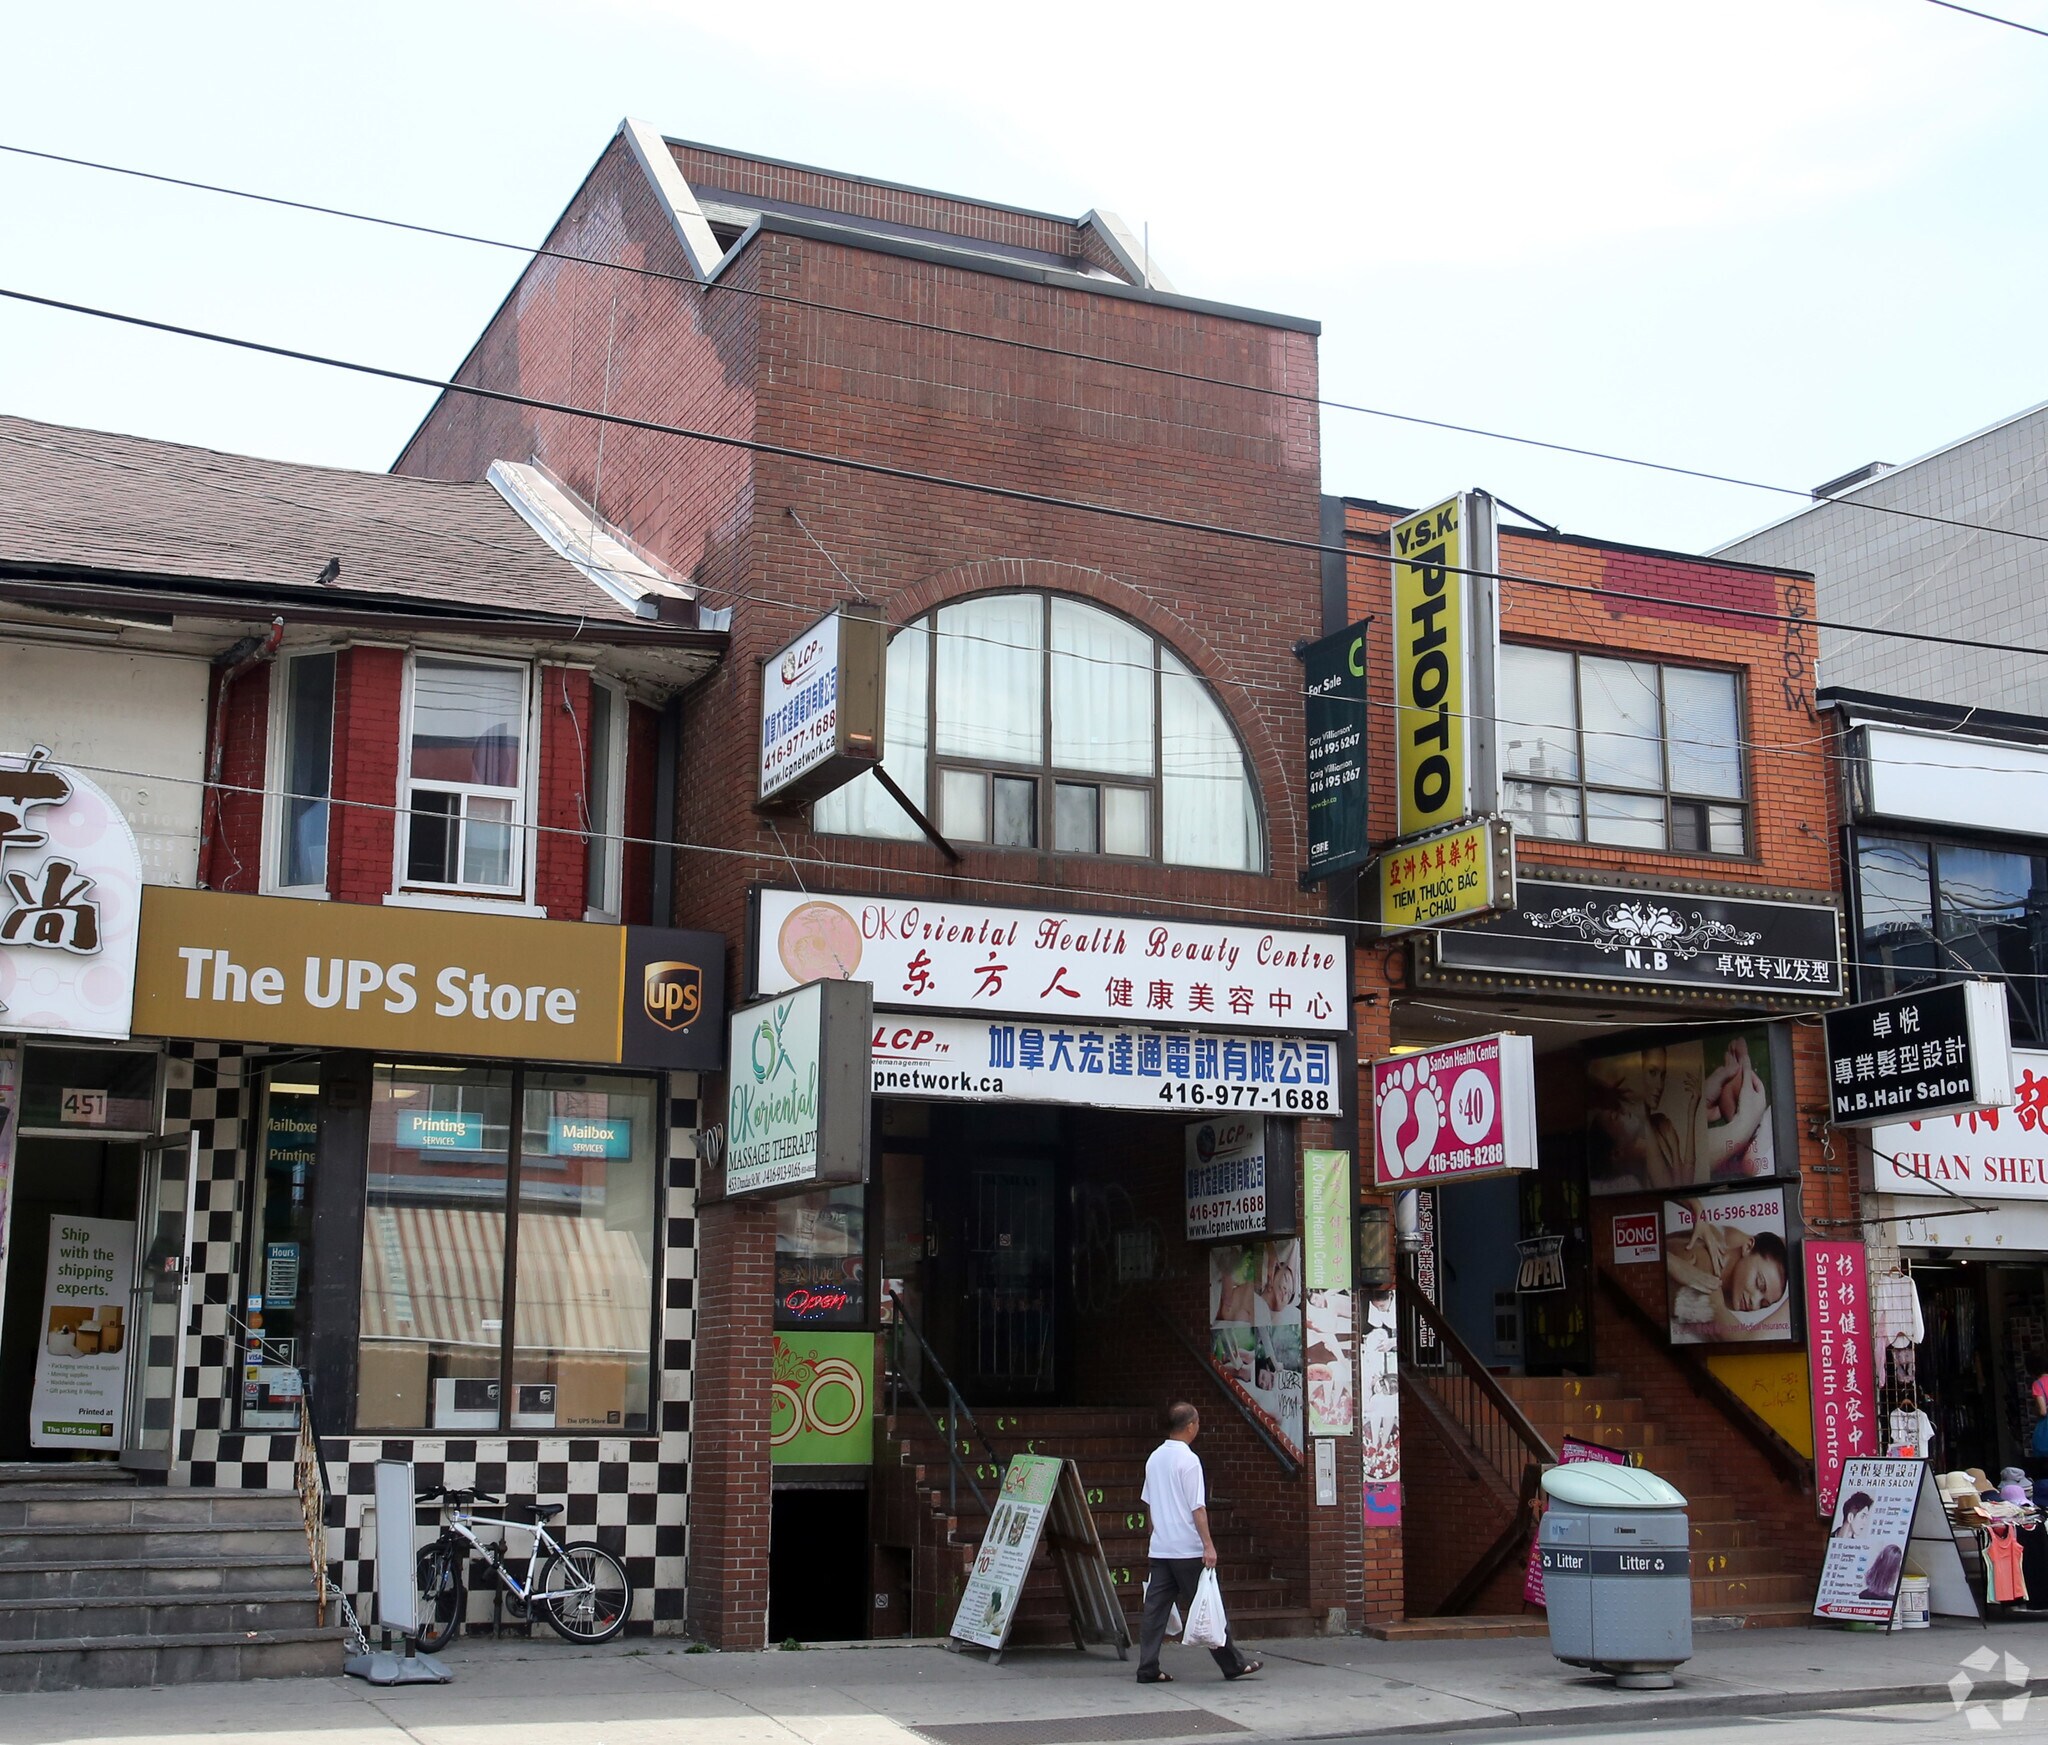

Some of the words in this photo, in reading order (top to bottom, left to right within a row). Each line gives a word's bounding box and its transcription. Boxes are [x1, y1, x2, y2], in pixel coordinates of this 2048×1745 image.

[1396, 507, 1458, 555] Y.S.K.
[797, 640, 818, 668] LCP
[1323, 674, 1342, 692] Sale
[1410, 542, 1451, 813] PHOTO
[764, 709, 836, 770] 416-977-1688
[1309, 747, 1323, 761] 416
[1340, 732, 1360, 750] 6247
[763, 735, 836, 792] www.lcpnetwork.ca
[1310, 780, 1323, 794] 416
[1342, 767, 1361, 783] 6267
[900, 907, 1018, 947] Oriental
[1034, 919, 1128, 955] Health
[1144, 926, 1241, 971] Beauty
[1256, 935, 1336, 970] Centre
[1715, 953, 1830, 984] 卓悦专业发型
[178, 947, 285, 1005] The
[304, 956, 418, 1014] UPS
[434, 966, 577, 1025] Store
[648, 981, 699, 1021] ups
[871, 1027, 934, 1051] LCP
[871, 1058, 931, 1068] elemanagement
[988, 1024, 1330, 1086] 加拿大宏達通電訊有限公司
[1429, 1052, 1453, 1072] SanSan
[1454, 1047, 1476, 1067] Health
[1477, 1044, 1499, 1063] Center
[1834, 1035, 1966, 1084] 專業髮型設計
[873, 1069, 1004, 1092] pnetwork.ca
[1159, 1082, 1330, 1111] 416-977-1688
[1916, 1078, 1970, 1100] Salon
[64, 1094, 104, 1115] 451
[1458, 1088, 1484, 1126] $40
[413, 1117, 467, 1136] Printing
[562, 1125, 615, 1141] Mailbox
[1218, 1124, 1245, 1146] LCP
[422, 1136, 455, 1146] SERVICES
[572, 1143, 604, 1153] SERVICES
[728, 1142, 770, 1172] MASSAGE
[772, 1130, 818, 1161] THERAPY
[269, 1148, 316, 1165] Printing
[1428, 1143, 1503, 1173] 416-596-8288
[1892, 1152, 1971, 1181] CHAN
[1189, 1195, 1264, 1221] 416-977-1688
[1700, 1202, 1779, 1223] 416-596-8288
[61, 1227, 90, 1244] Ship
[1188, 1215, 1266, 1237] www.lcpnetwork.ca
[1313, 1216, 1326, 1249] Health
[1617, 1226, 1654, 1245] DONG
[60, 1246, 89, 1259] with
[93, 1248, 114, 1260] the
[272, 1247, 294, 1257] Hours
[58, 1263, 113, 1282] shipping
[1314, 1251, 1326, 1285] Centre
[1520, 1255, 1561, 1288] OPEN
[56, 1283, 108, 1297] experts.
[1816, 1253, 1830, 1324] Sansan
[1820, 1329, 1838, 1396] Health
[1835, 1254, 1866, 1458] 杉杉健康美容中
[79, 1408, 104, 1416] Printed
[106, 1408, 113, 1416] at
[78, 1427, 97, 1435] Store
[1824, 1401, 1839, 1470] Centre
[1848, 1479, 1864, 1487] N.B.
[1866, 1479, 1886, 1487] HAIR
[1557, 1553, 1583, 1569] Litter
[1620, 1554, 1650, 1571] Litter
